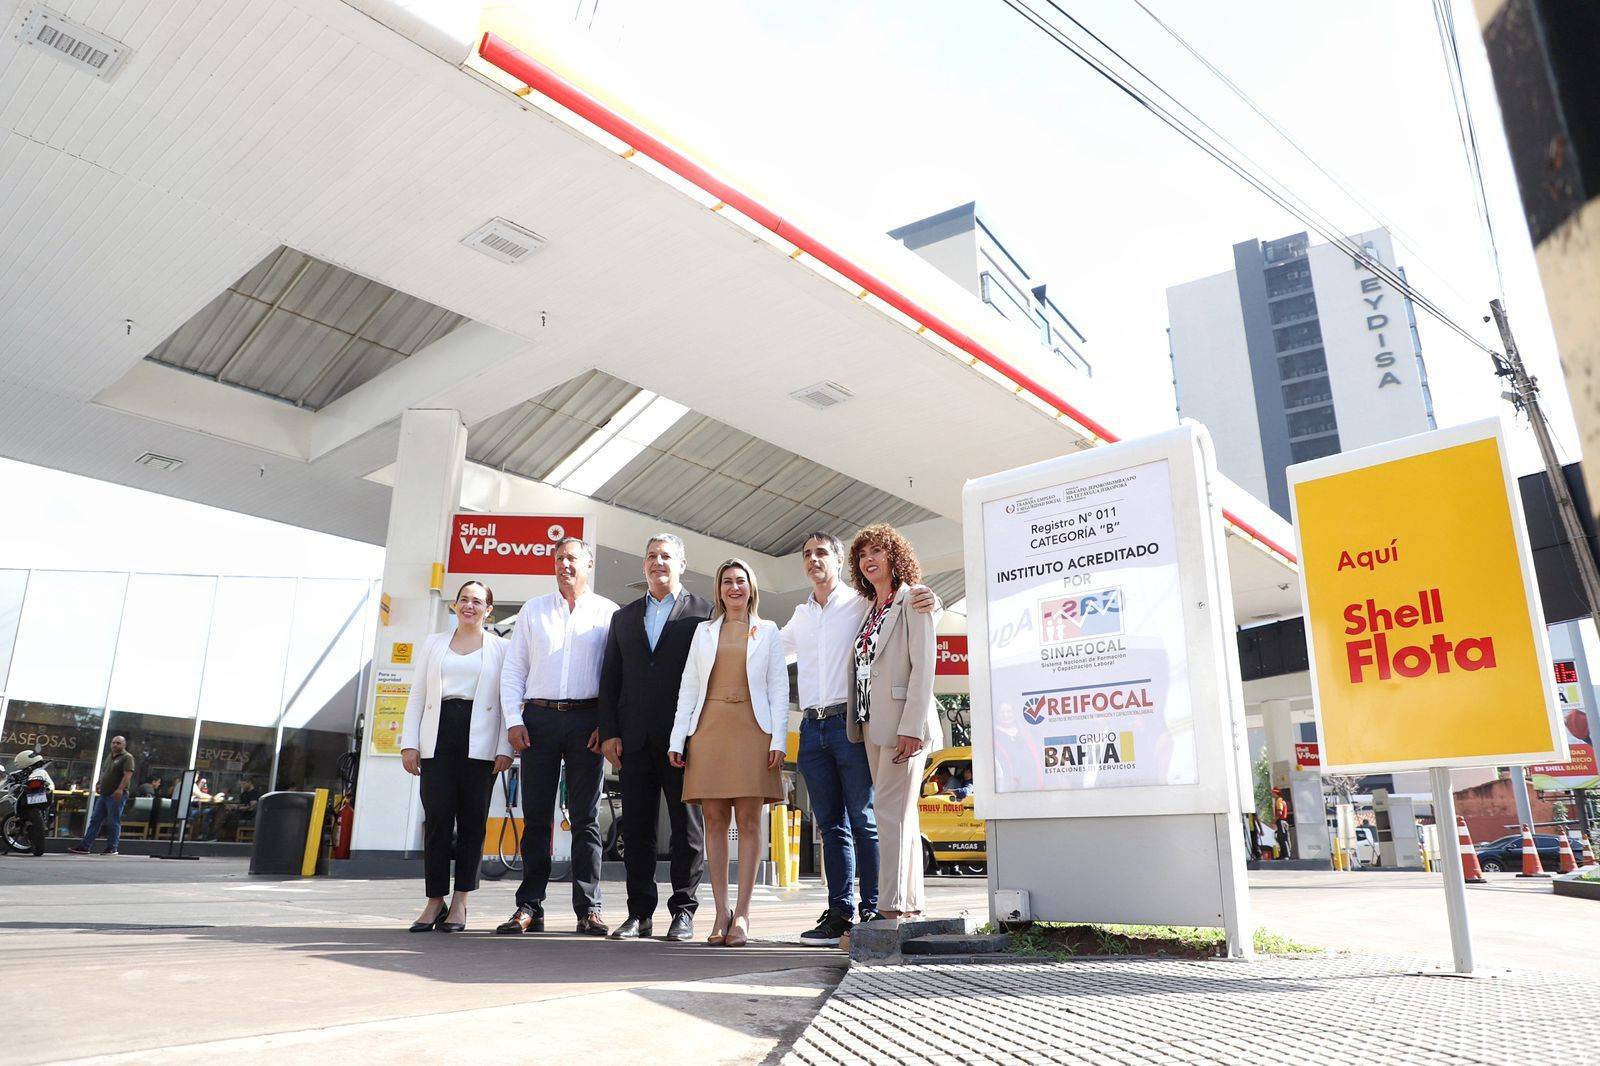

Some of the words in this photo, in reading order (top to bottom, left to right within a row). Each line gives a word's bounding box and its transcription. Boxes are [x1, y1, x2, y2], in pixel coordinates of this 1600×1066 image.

[460, 523, 496, 536] Shell
[1031, 518, 1075, 534] Registro
[1078, 511, 1092, 523] N°
[1096, 507, 1117, 519] 011
[460, 537, 556, 556] V-Power
[1030, 526, 1096, 549] CATEGORÍA
[997, 561, 1063, 583] INSTITUTO
[1067, 542, 1159, 570] ACREDITADO
[1337, 538, 1399, 571] Aquí
[1063, 573, 1092, 588] POR
[1343, 588, 1444, 635] Shell
[1041, 638, 1126, 660] SINAFOCAL
[1097, 653, 1127, 661] Formación
[1346, 632, 1497, 684] Flota
[1048, 688, 1153, 715] REIFOCAL
[1079, 731, 1117, 744] GRUPO
[1045, 766, 1086, 774] ESTACIONES
[1099, 763, 1136, 771] SERVICIOS
[919, 804, 940, 812] TRULY
